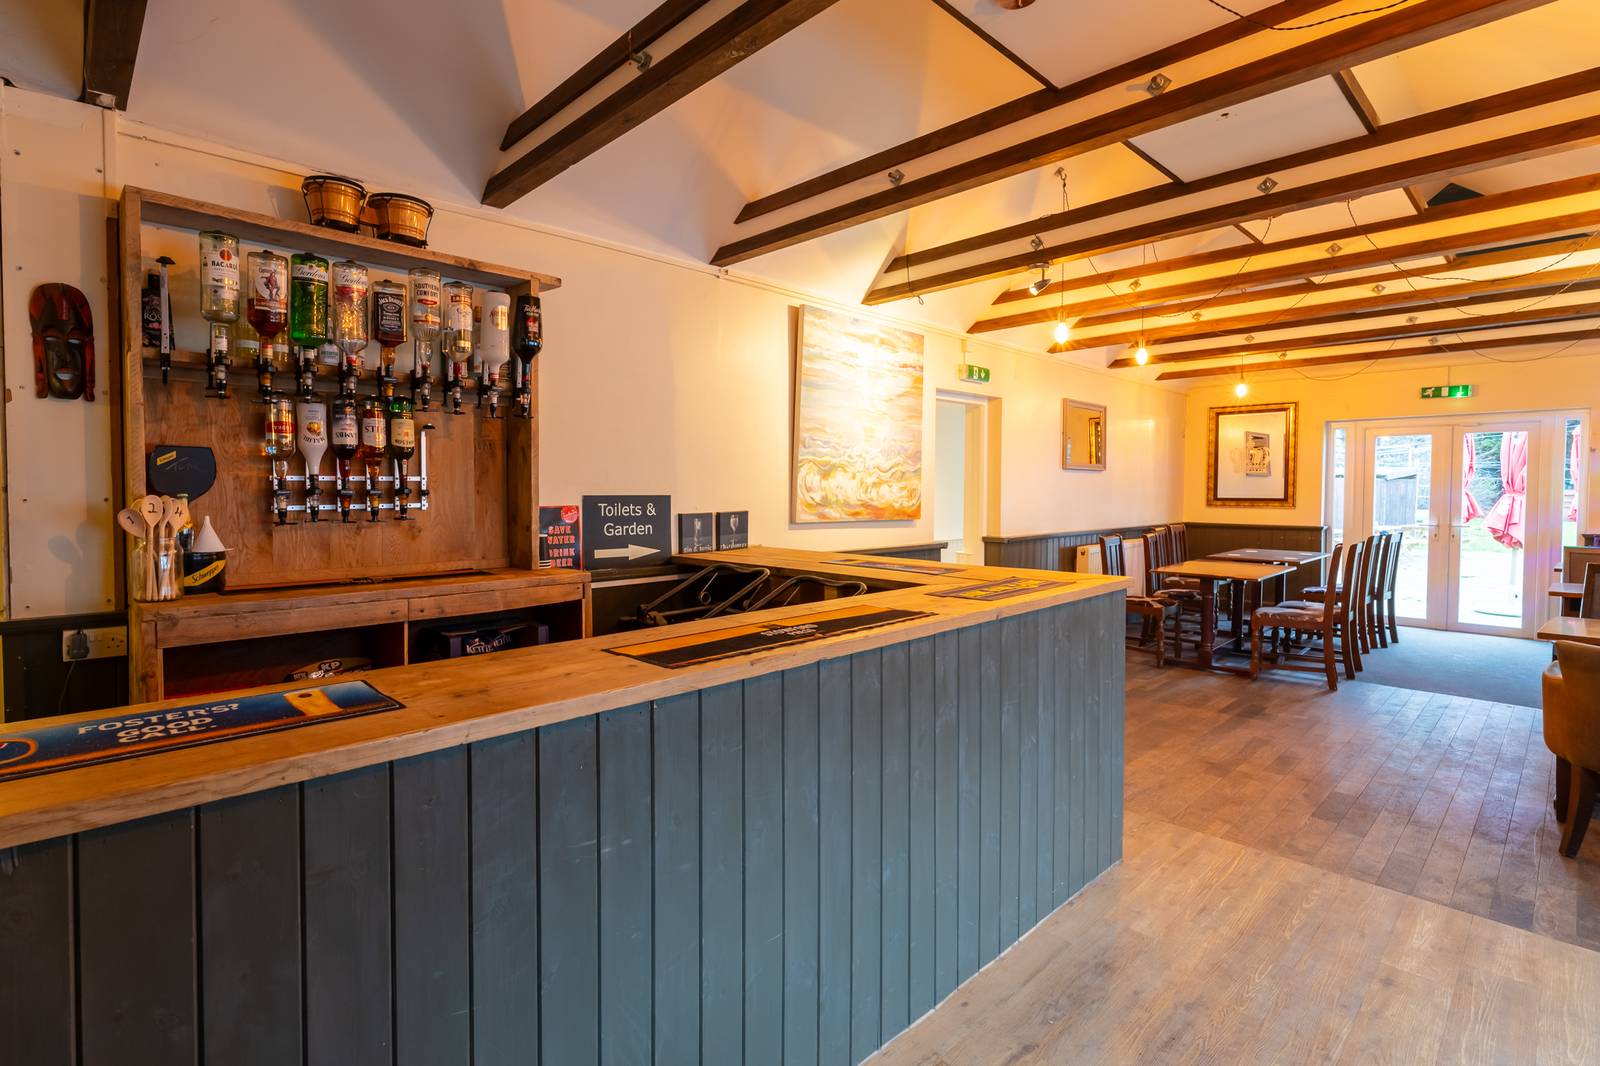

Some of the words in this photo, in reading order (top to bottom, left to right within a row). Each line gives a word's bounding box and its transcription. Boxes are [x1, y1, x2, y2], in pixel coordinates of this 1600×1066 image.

[416, 289, 440, 298] COMFORT
[147, 502, 158, 514] 2
[174, 506, 184, 518] 4
[598, 503, 642, 516] Toilets
[646, 502, 657, 516] &
[127, 515, 135, 525] 1
[548, 526, 571, 535] SAVE
[603, 522, 653, 537] Garden
[547, 535, 575, 545] WATER
[78, 703, 240, 735] FOSTER'S?
[116, 717, 213, 738] GOOD
